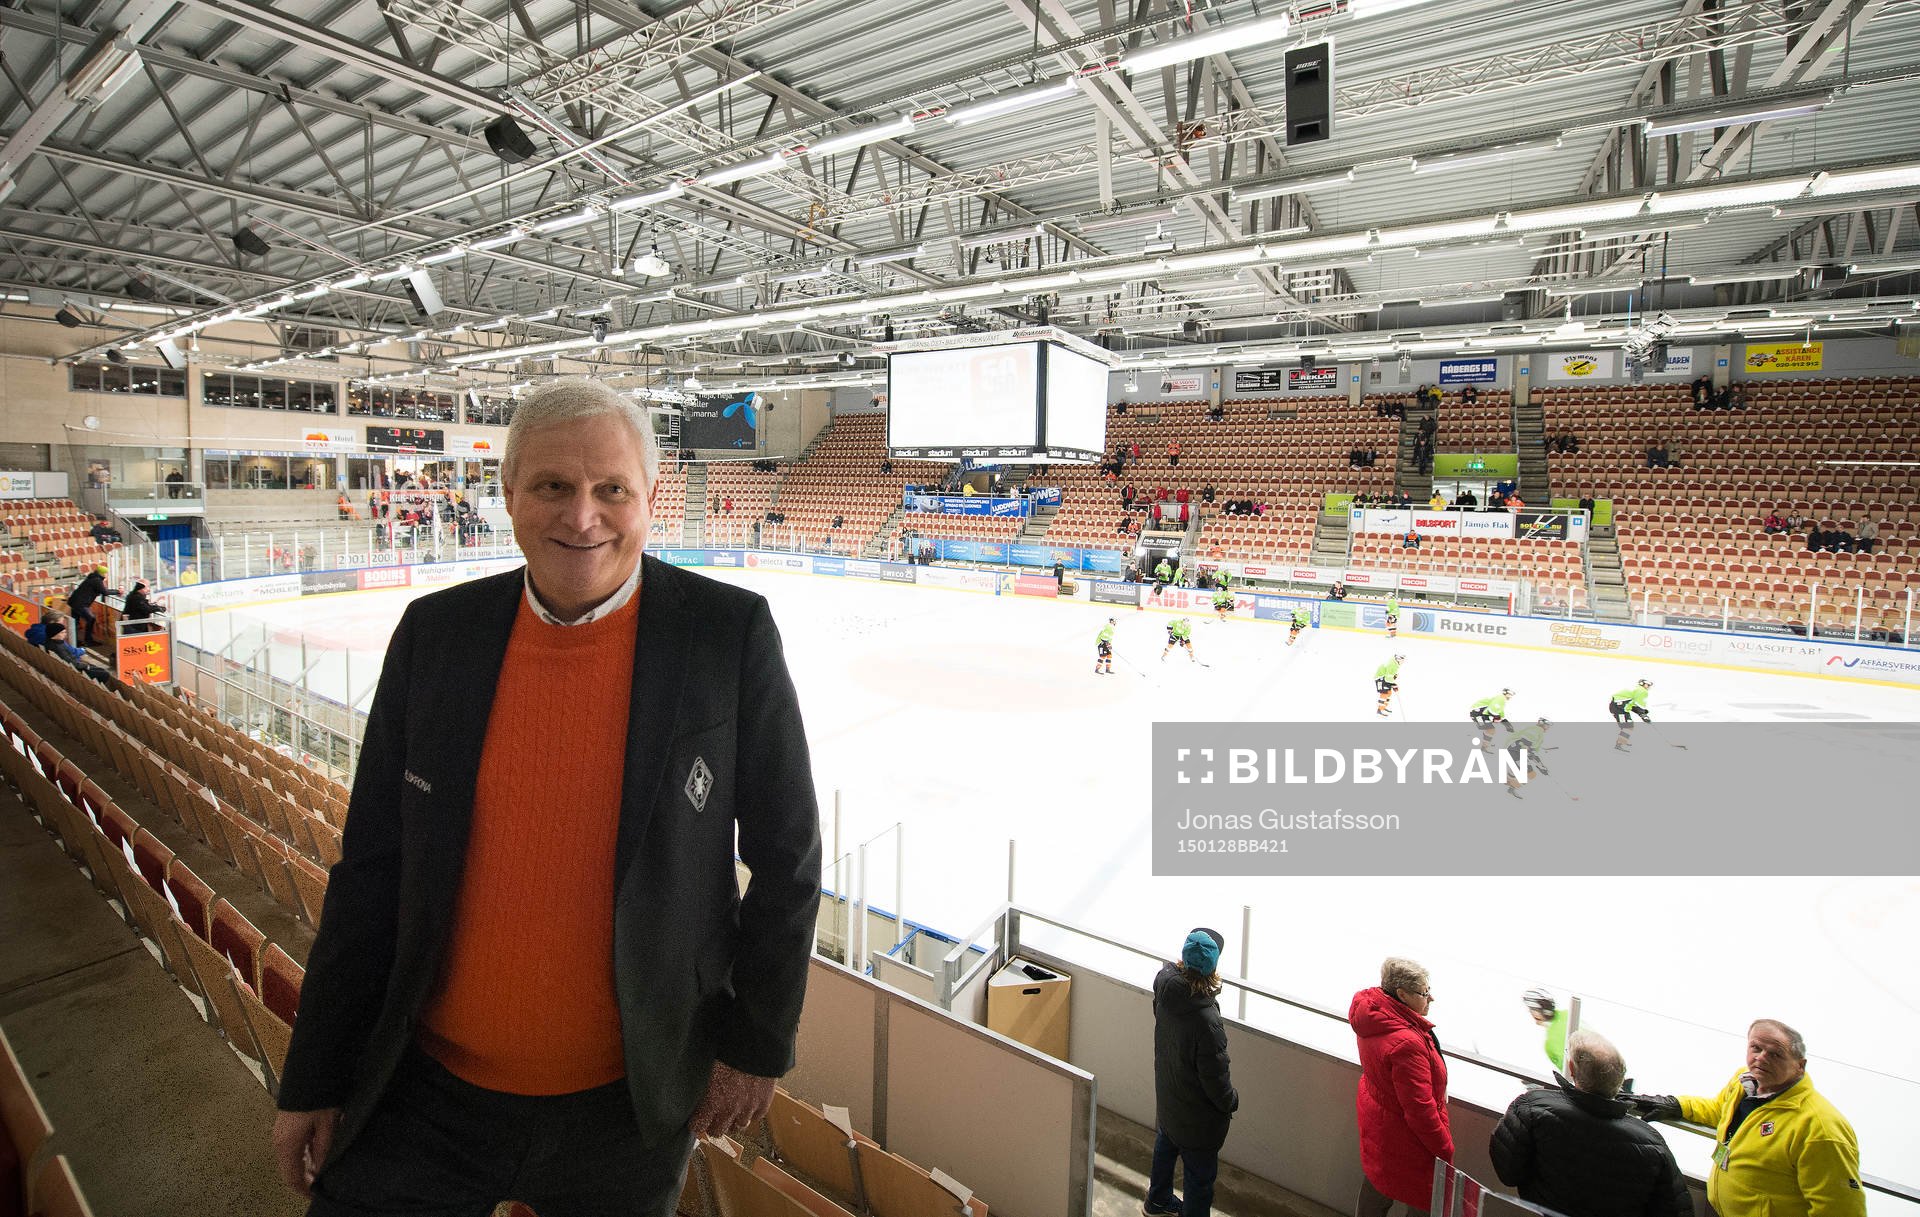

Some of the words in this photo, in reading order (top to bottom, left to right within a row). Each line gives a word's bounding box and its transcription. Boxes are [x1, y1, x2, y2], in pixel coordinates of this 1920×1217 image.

[1776, 347, 1821, 355] ASSISTANCE
[1441, 364, 1480, 374] RÅBERGS
[1481, 363, 1496, 372] BIL
[1415, 519, 1457, 529] BILSPORT
[1492, 520, 1510, 529] Flak
[1462, 583, 1487, 591] RICOH
[1441, 618, 1507, 636] Roxtec
